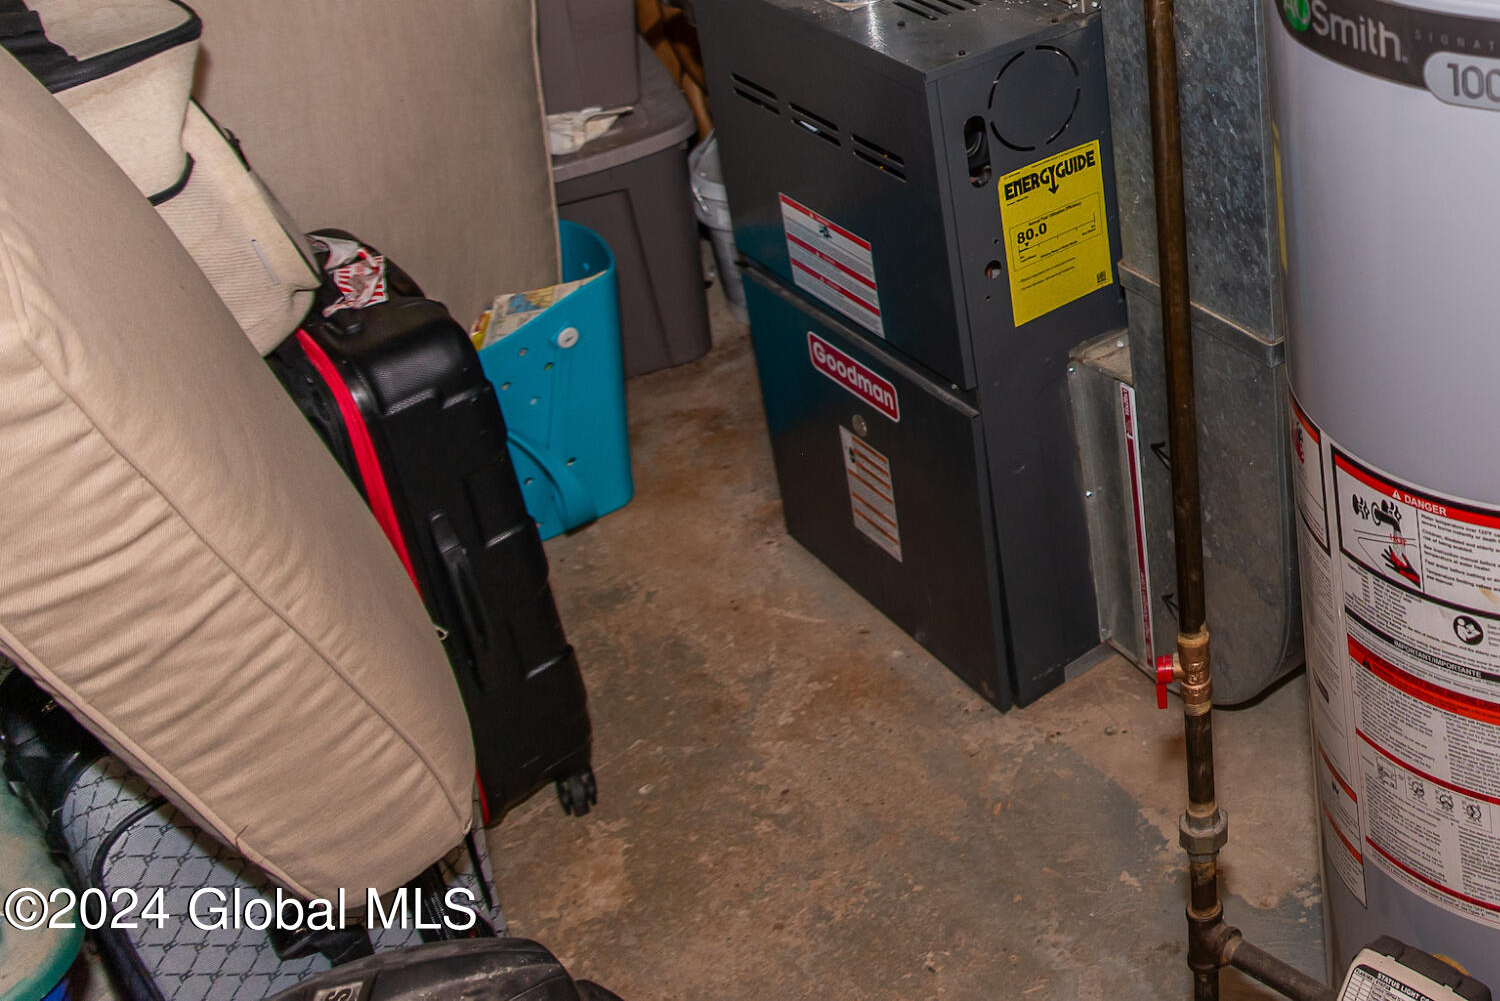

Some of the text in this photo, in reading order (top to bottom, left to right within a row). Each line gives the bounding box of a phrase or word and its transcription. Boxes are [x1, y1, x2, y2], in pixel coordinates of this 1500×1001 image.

[1003, 150, 1096, 201] ENERGYGUIDE
[1017, 222, 1047, 244] 80.0
[812, 341, 895, 412] Goodman
[1404, 494, 1448, 517] DANGER
[1389, 533, 1407, 547] HOT
[1393, 640, 1482, 679] IMPORTANT/IMPORTANTE
[1377, 972, 1401, 989] STATUS
[1401, 985, 1421, 1001] LIGHT
